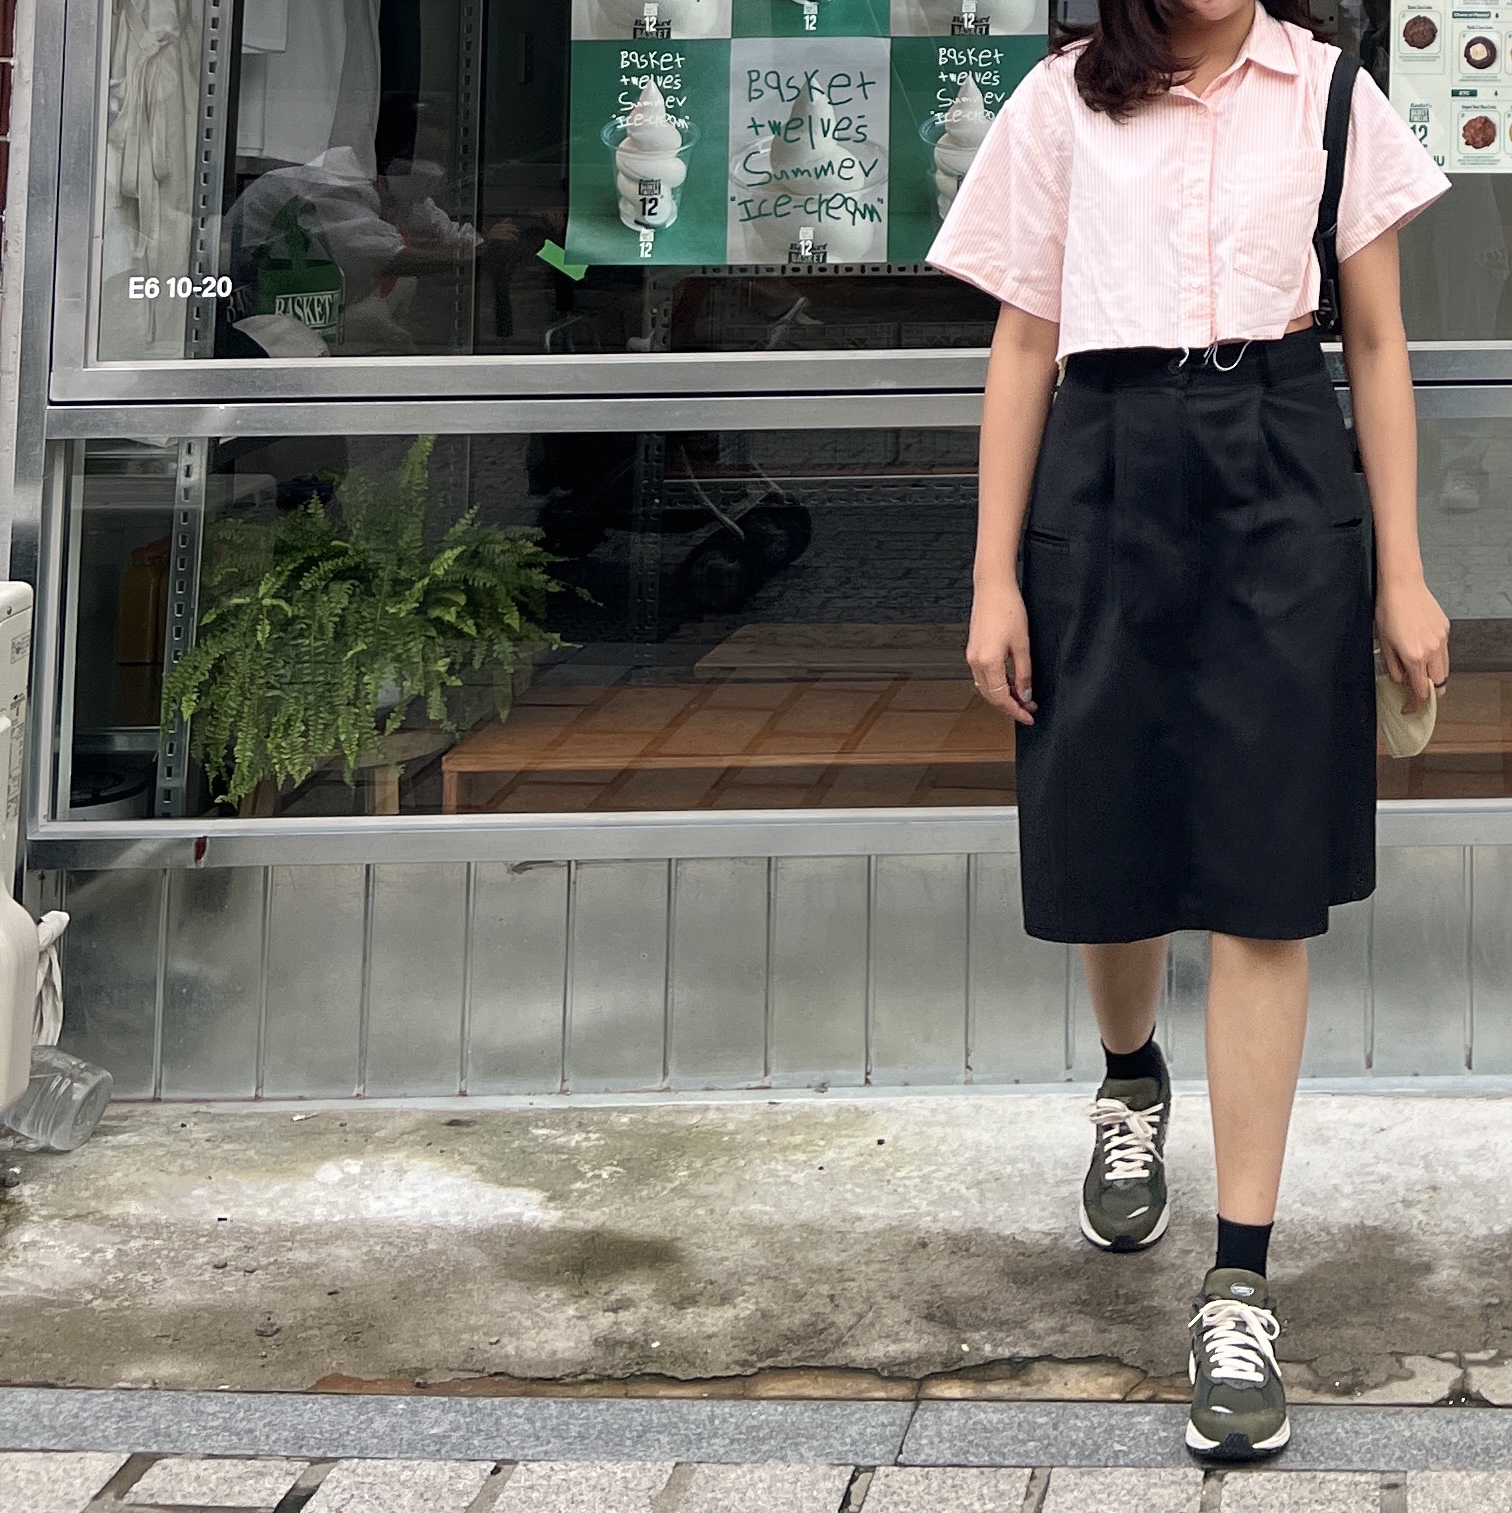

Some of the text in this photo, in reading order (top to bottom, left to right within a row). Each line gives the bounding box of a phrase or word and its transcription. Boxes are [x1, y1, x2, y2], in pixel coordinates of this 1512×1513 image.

[644, 16, 657, 33] 12
[804, 15, 817, 31] 12
[962, 12, 975, 29] 12
[620, 50, 685, 71] Basket
[938, 47, 1004, 68] Basket
[747, 69, 876, 105] Basket
[930, 109, 996, 125] "Ice-crea
[640, 197, 658, 216] 12
[640, 242, 652, 257] 12
[800, 240, 813, 256] 12
[129, 276, 233, 299] E6 10-20
